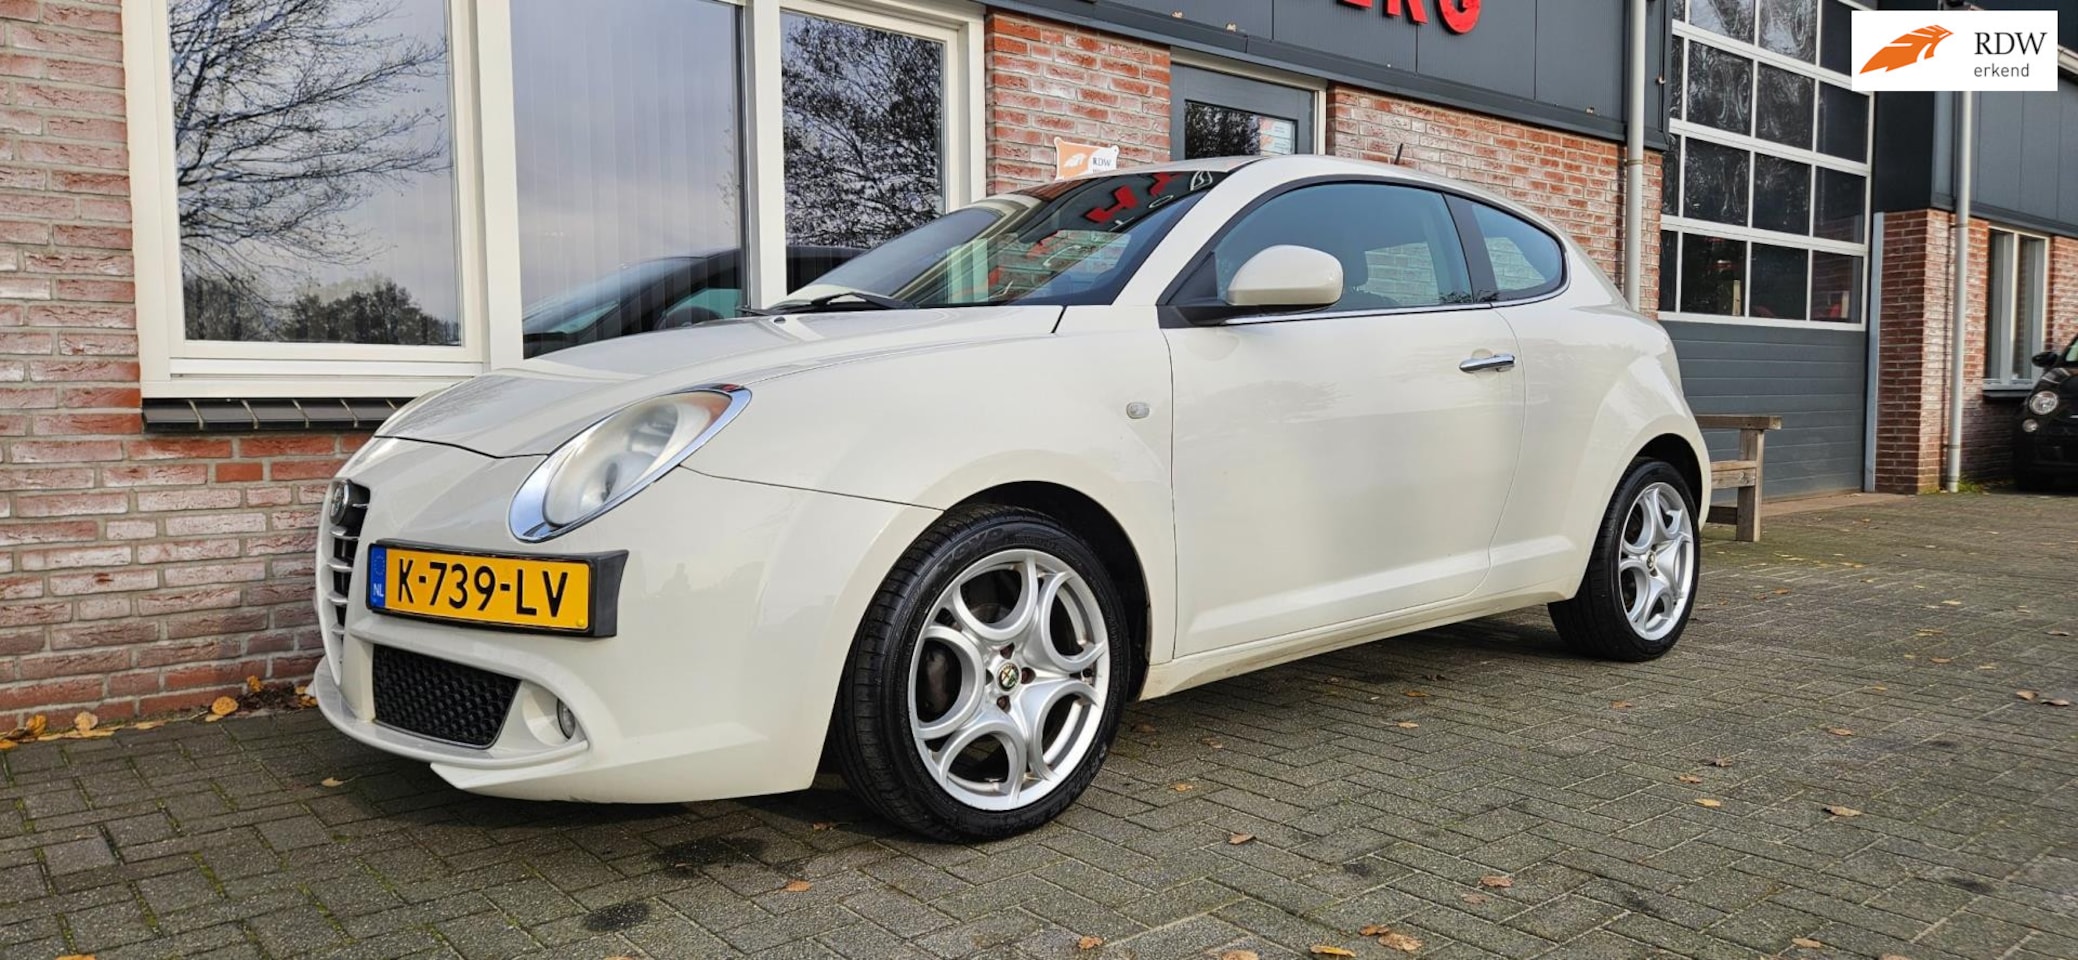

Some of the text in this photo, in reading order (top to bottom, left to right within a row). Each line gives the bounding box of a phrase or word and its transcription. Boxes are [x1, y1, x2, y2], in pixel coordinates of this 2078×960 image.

[1092, 157, 1112, 167] RDW
[373, 583, 384, 598] NL
[398, 558, 568, 617] K-739-LV
